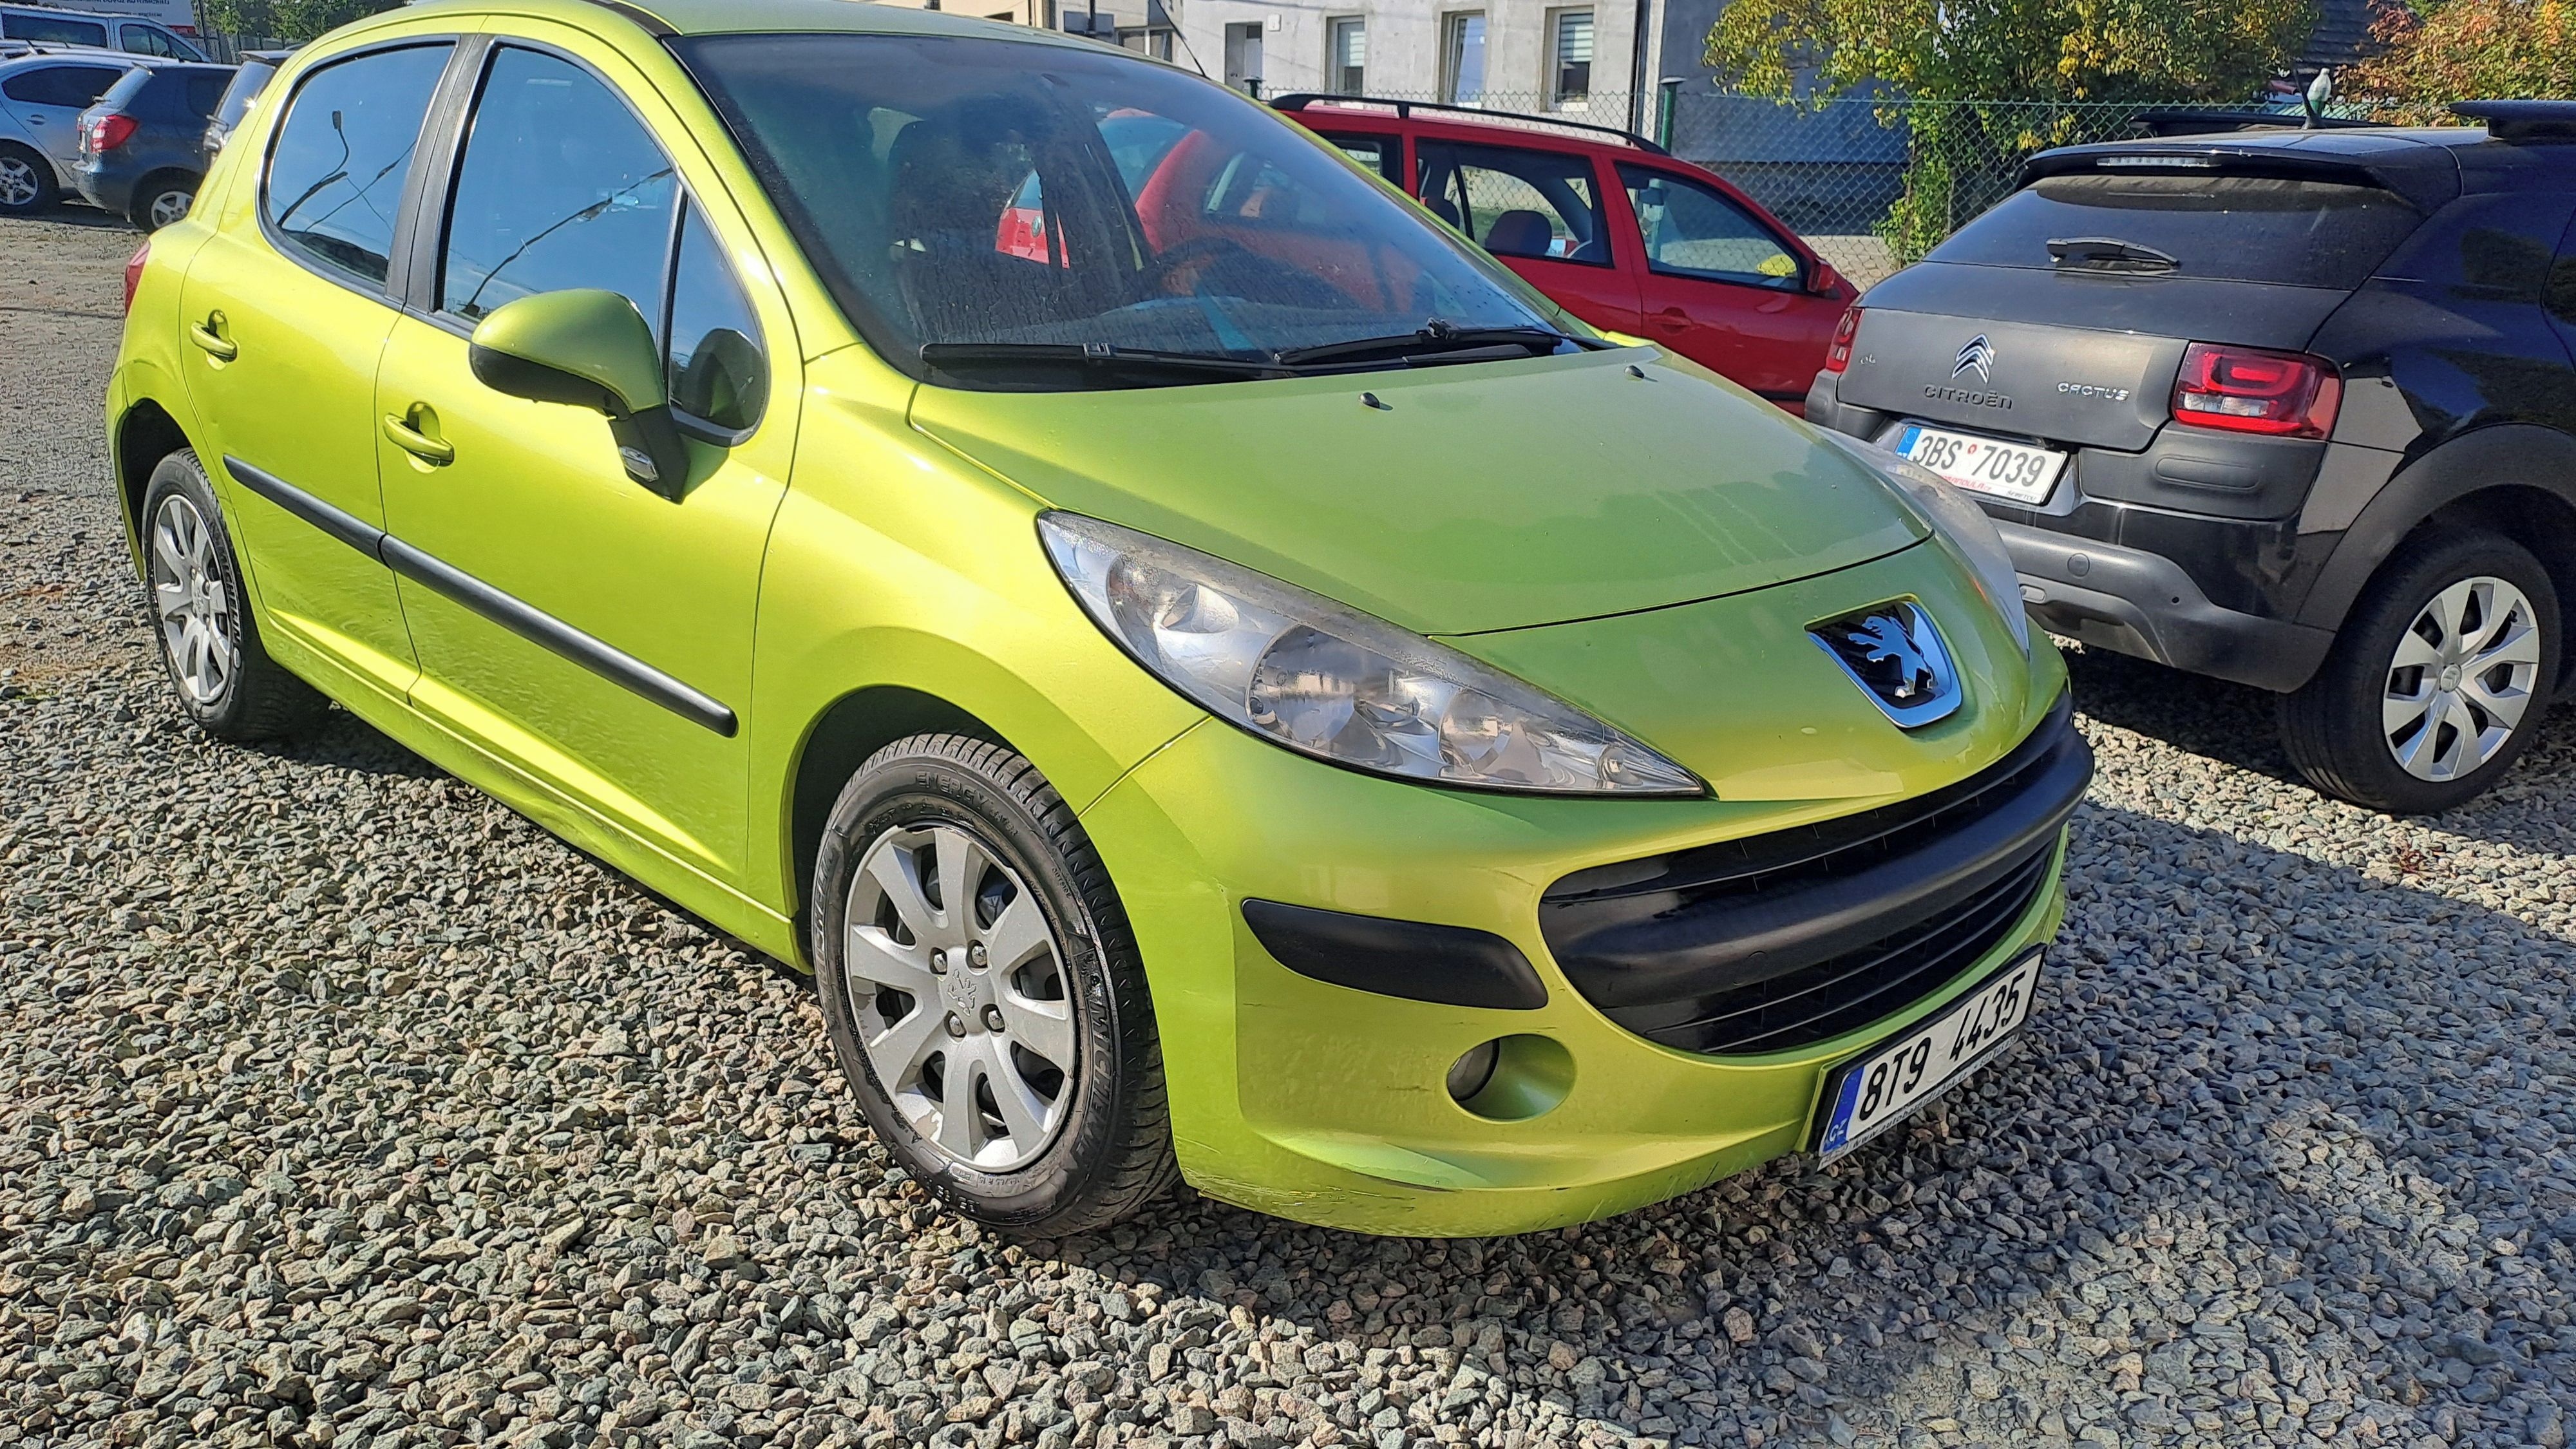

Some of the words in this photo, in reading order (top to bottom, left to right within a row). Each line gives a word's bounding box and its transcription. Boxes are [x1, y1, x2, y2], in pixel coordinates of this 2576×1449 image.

[1922, 384, 2013, 410] CITROËN
[2056, 381, 2130, 401] CACTUS
[1912, 435, 1963, 469] 3BS
[1971, 445, 2047, 487] 7039
[915, 770, 989, 810] ENERGY
[1859, 1037, 1931, 1122] 8T9
[1949, 969, 2027, 1062] 4435
